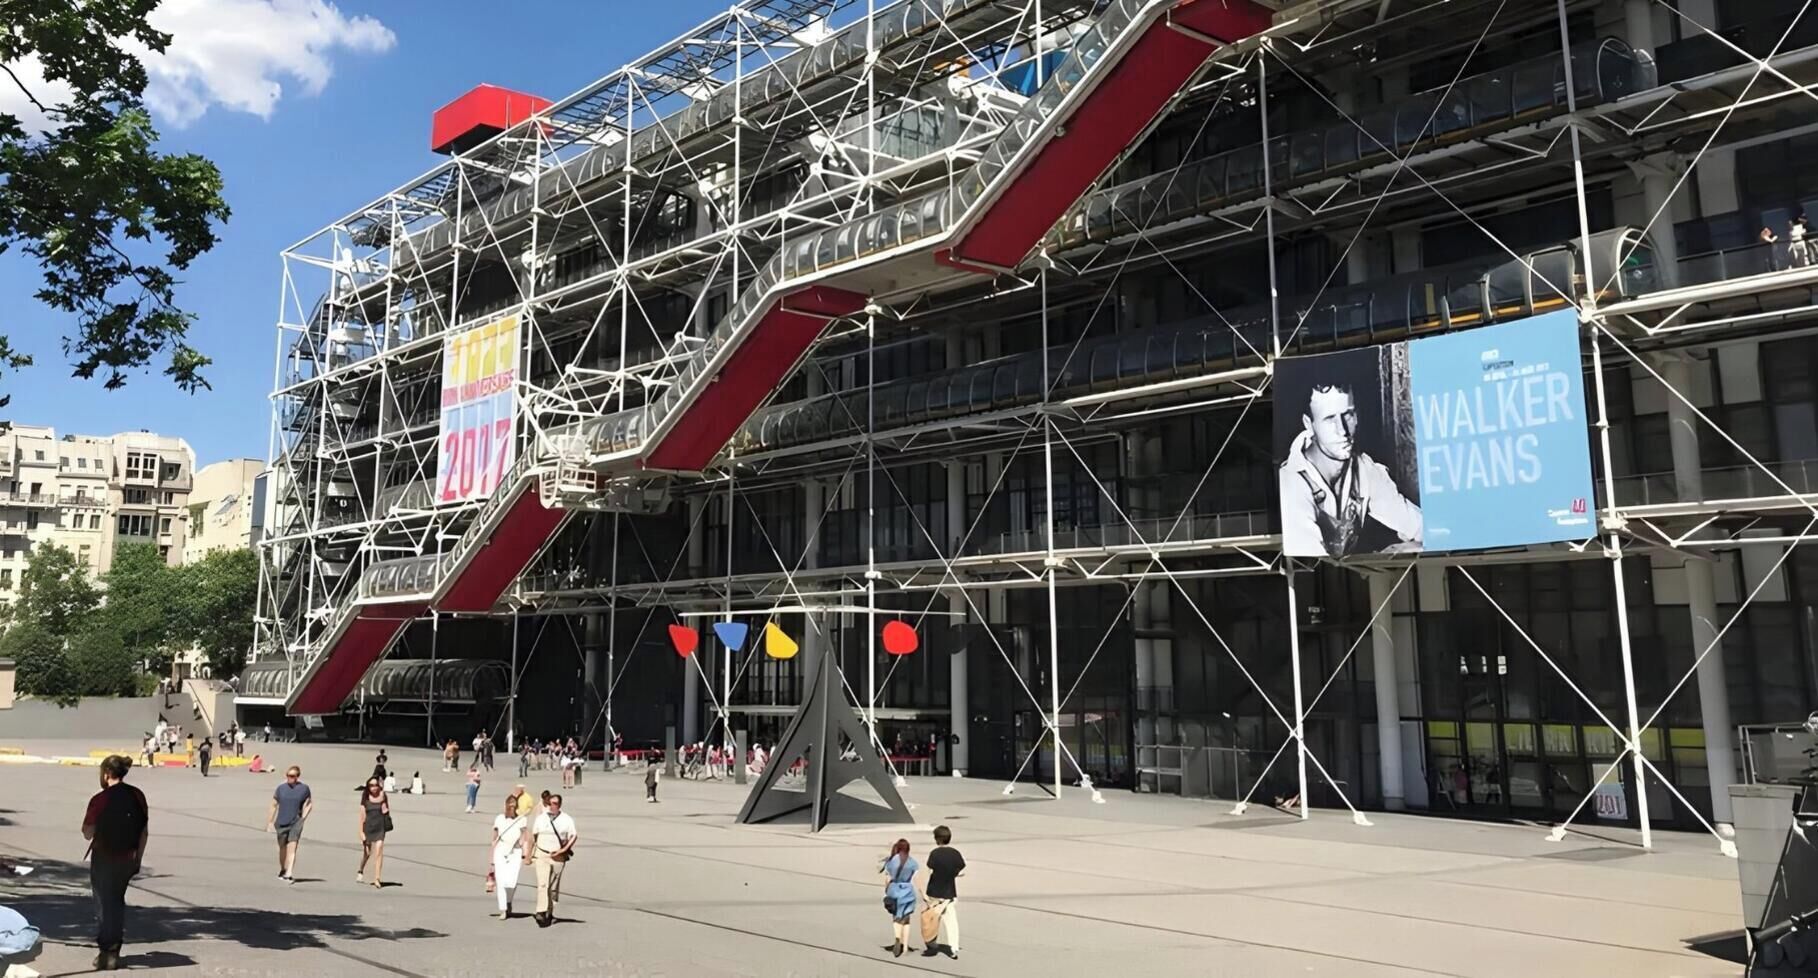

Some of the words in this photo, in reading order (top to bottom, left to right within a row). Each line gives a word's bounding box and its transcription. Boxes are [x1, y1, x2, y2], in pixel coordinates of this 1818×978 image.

[1418, 371, 1575, 441] WALKER
[443, 418, 511, 500] 2017
[1422, 433, 1542, 495] EVANS
